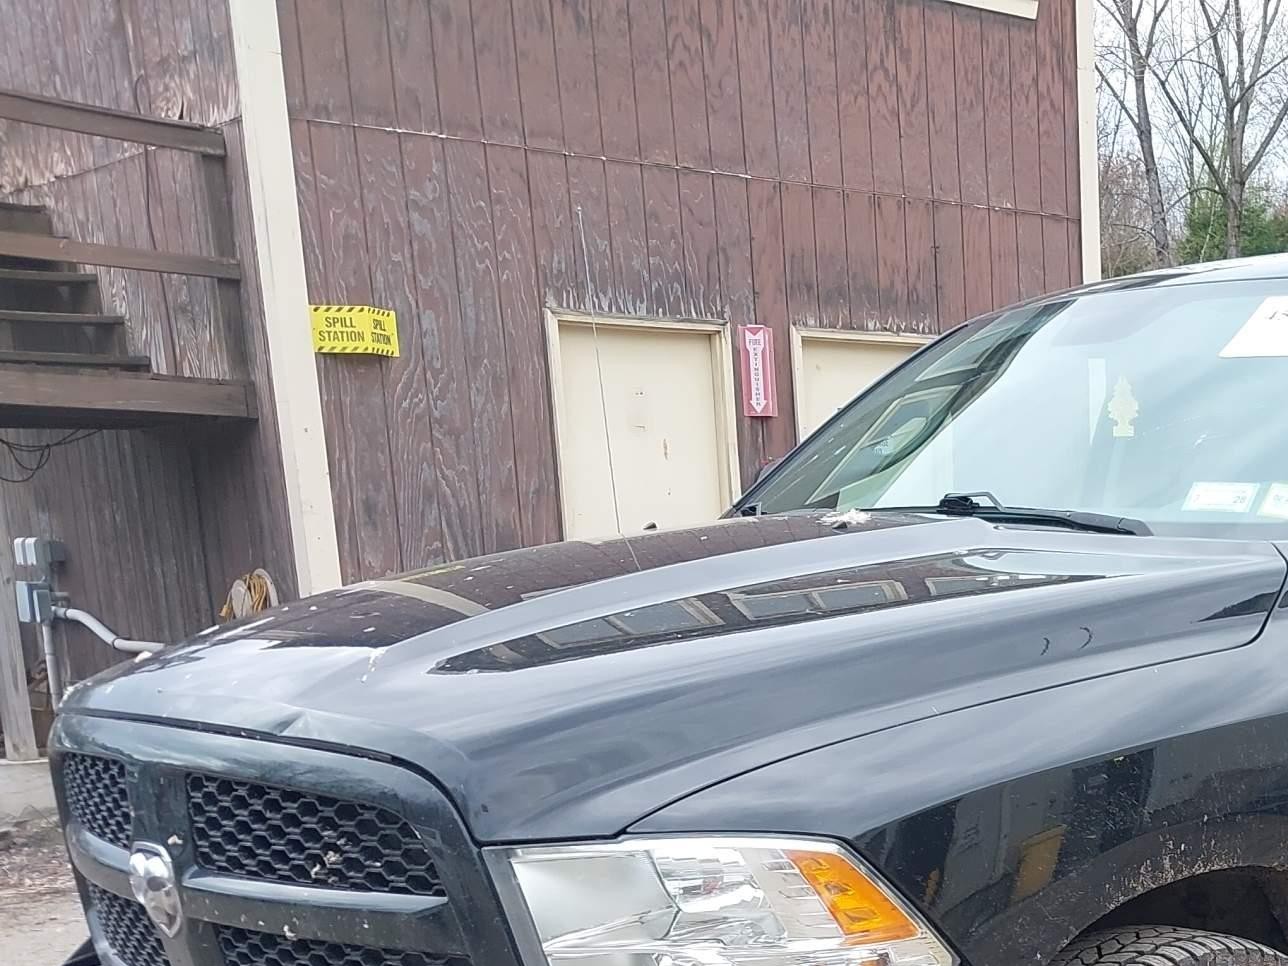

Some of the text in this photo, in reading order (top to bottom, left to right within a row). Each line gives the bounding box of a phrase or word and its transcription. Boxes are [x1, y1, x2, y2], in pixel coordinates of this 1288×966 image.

[325, 317, 355, 328] SPILL
[373, 319, 386, 331] SPILL
[319, 331, 365, 342] STATION
[371, 332, 391, 345] STATION
